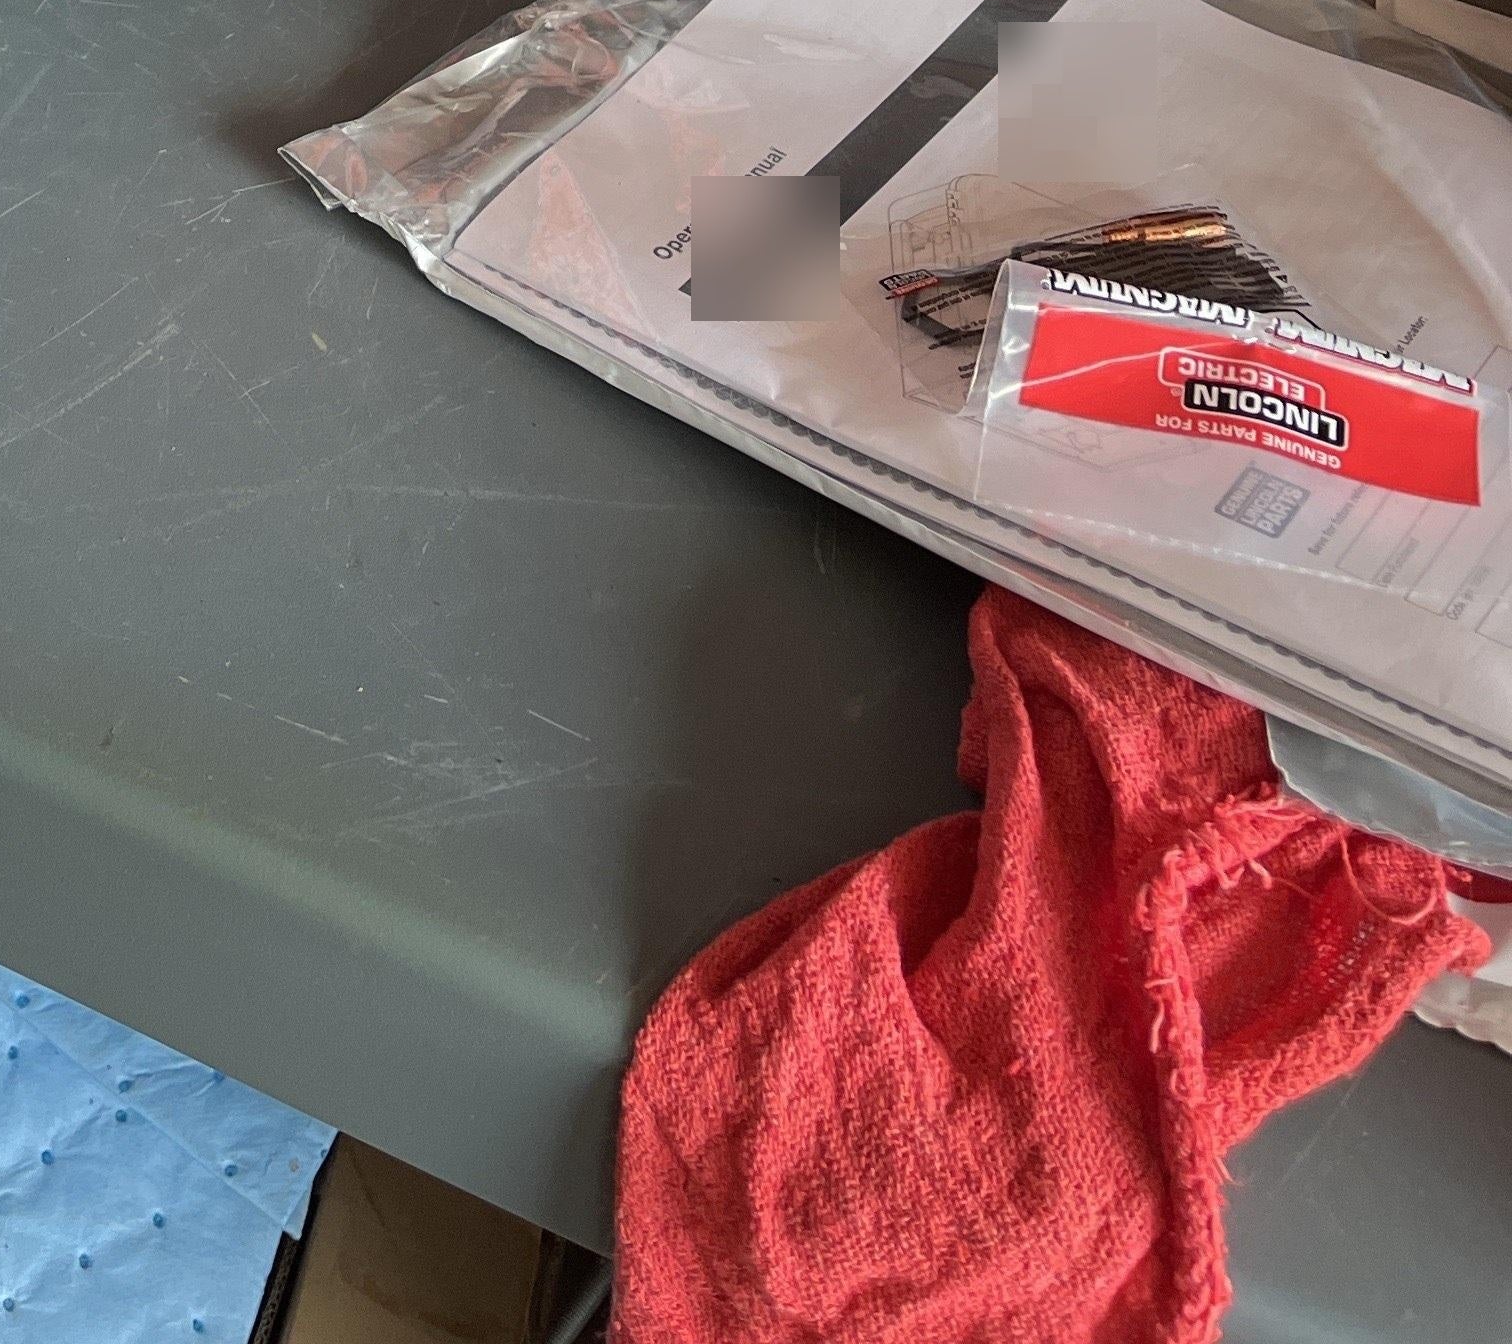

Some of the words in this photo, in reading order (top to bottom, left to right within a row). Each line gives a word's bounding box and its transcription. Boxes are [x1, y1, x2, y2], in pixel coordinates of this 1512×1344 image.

[1177, 355, 1305, 402] ELECTRIC
[1154, 413, 1193, 432] FOR
[1191, 382, 1339, 443] LINCOLN
[1196, 418, 1258, 443] PARTS
[1261, 429, 1342, 470] GENUINE
